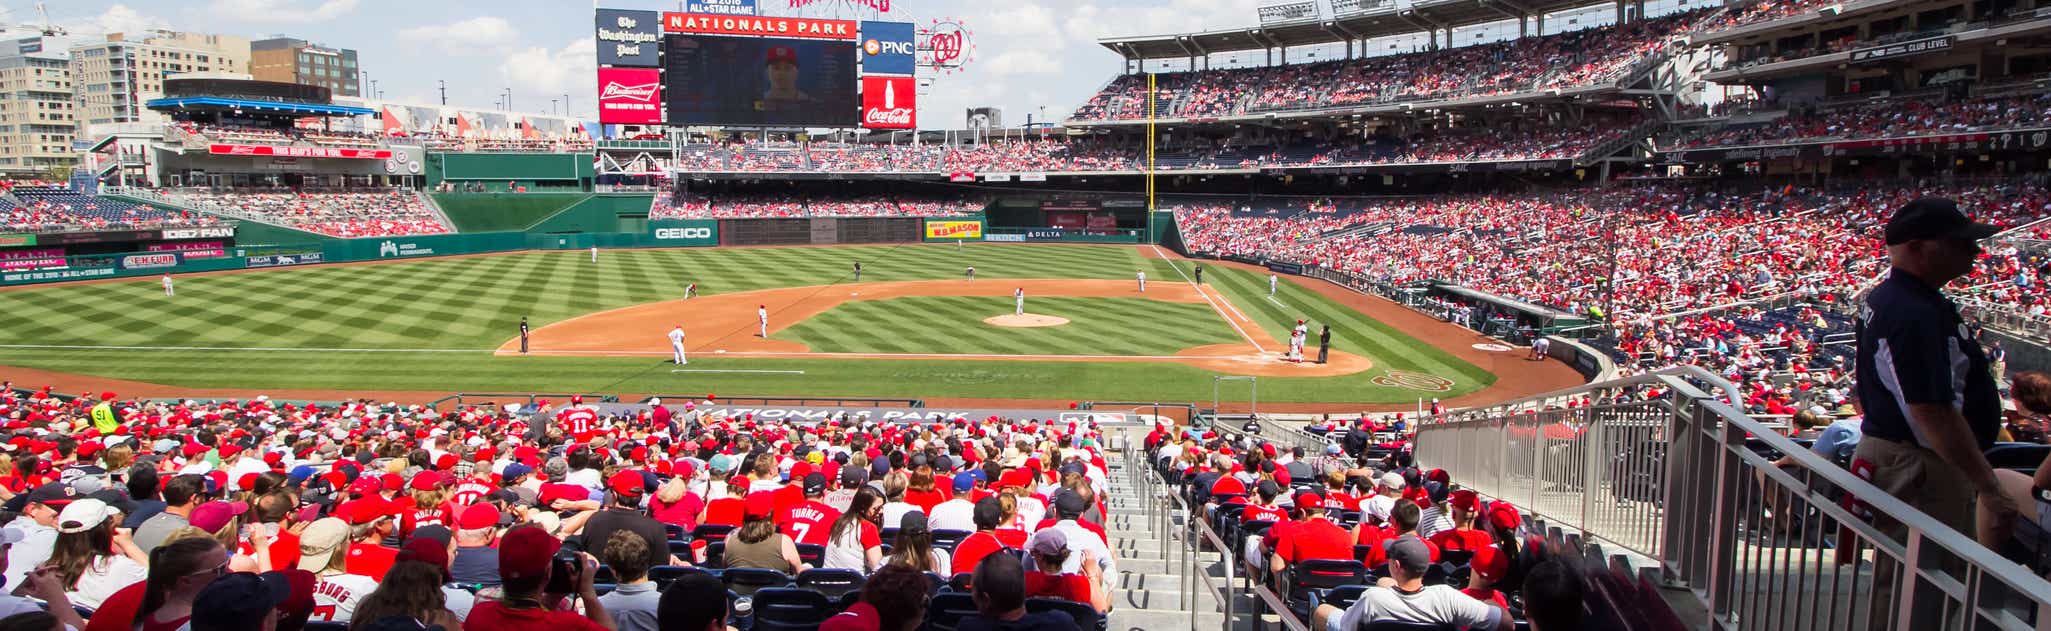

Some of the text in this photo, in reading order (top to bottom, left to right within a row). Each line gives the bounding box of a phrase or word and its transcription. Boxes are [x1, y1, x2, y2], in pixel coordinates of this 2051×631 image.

[730, 5, 754, 15] GAME
[617, 16, 637, 28] The
[671, 16, 847, 35] NATIONALS PARK
[598, 27, 657, 43] Washington
[616, 44, 640, 57] Post
[881, 41, 913, 55] PNC
[1908, 39, 1948, 52] CLUB LEVEL
[605, 85, 653, 96] Budweiser
[1666, 151, 1687, 163] SAIC
[201, 228, 234, 238] FAN
[655, 227, 711, 239] GEICO
[249, 256, 271, 264] MGM
[301, 253, 320, 261] MGM
[883, 411, 969, 422] PARK
[573, 419, 588, 433] 11
[791, 506, 825, 522] TURNER
[792, 521, 811, 544] 7
[313, 580, 351, 603] SBURG
